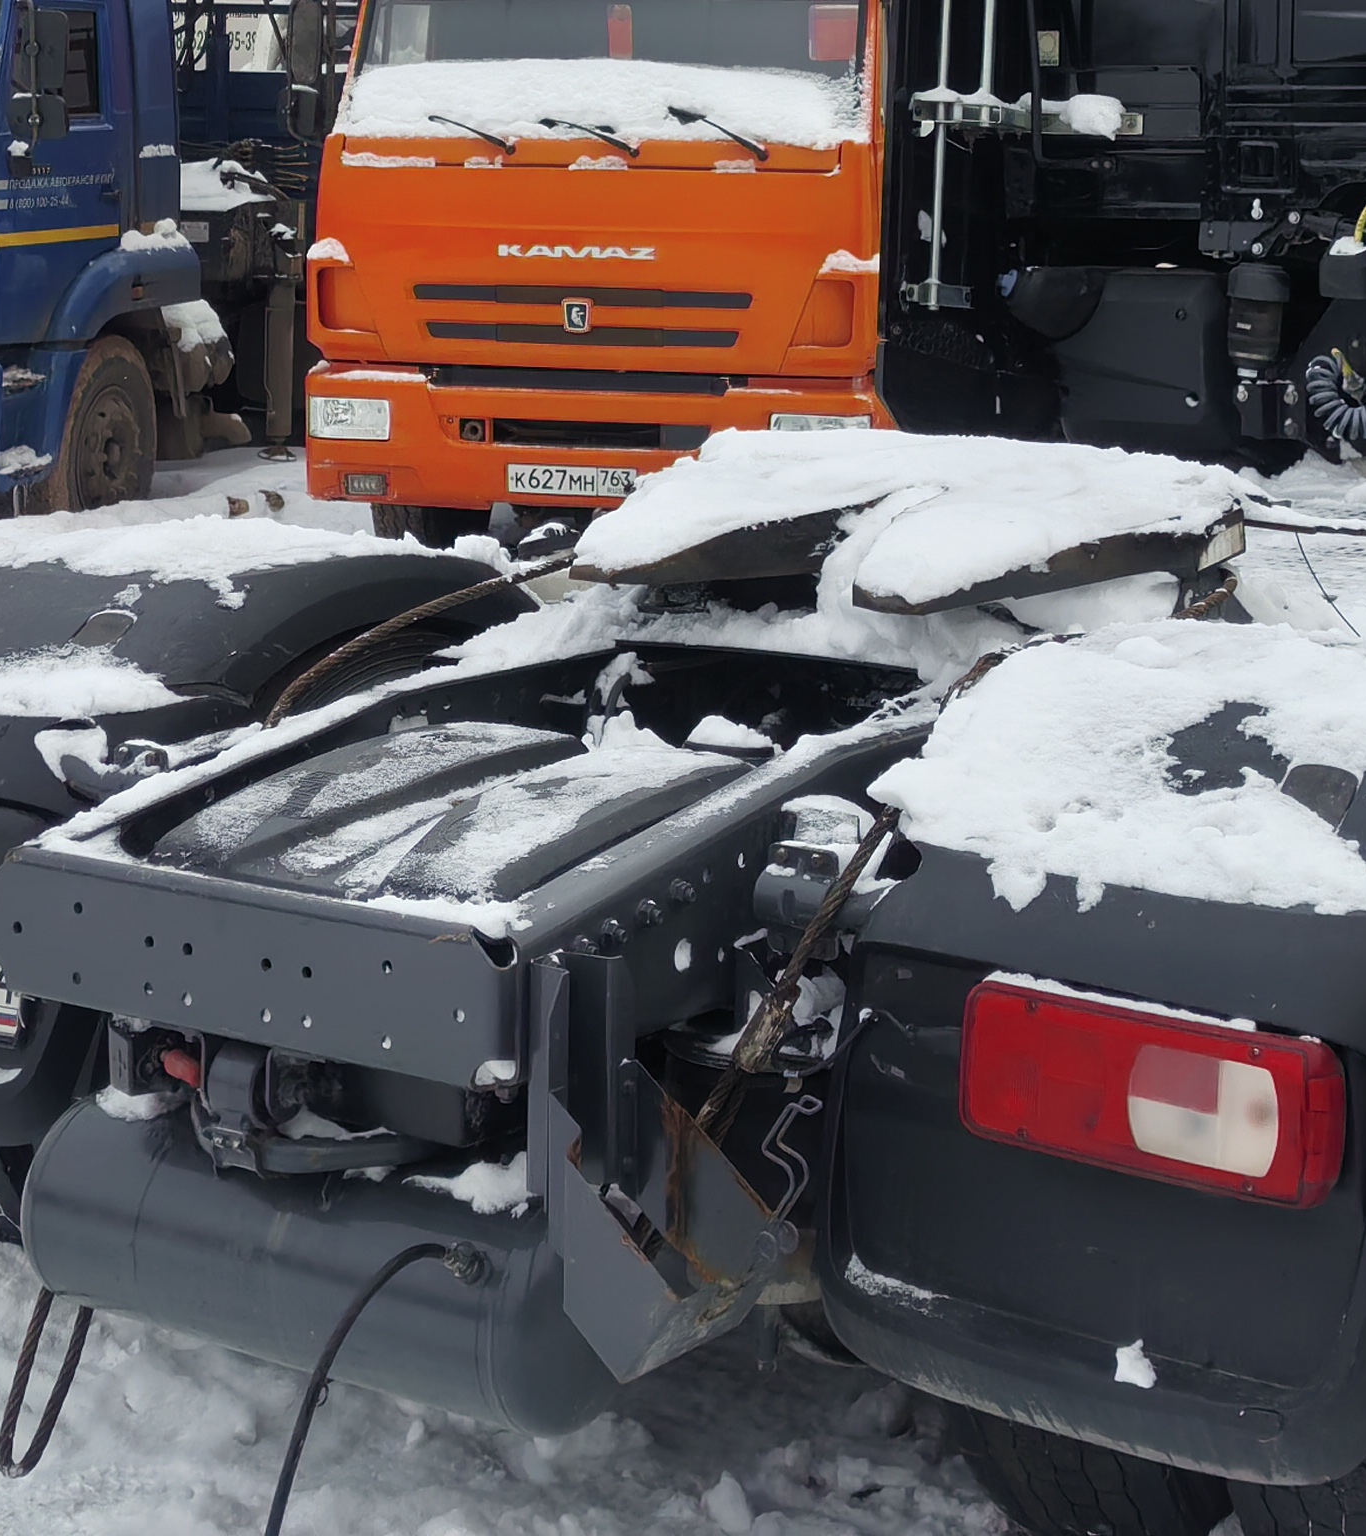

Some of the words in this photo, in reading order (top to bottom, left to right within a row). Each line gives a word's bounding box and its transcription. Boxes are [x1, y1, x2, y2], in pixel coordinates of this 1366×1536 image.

[9, 176, 49, 190] ПРОДАЖА
[498, 244, 655, 260] KAMAZ
[515, 468, 594, 492] К627МН
[599, 470, 631, 487] 763
